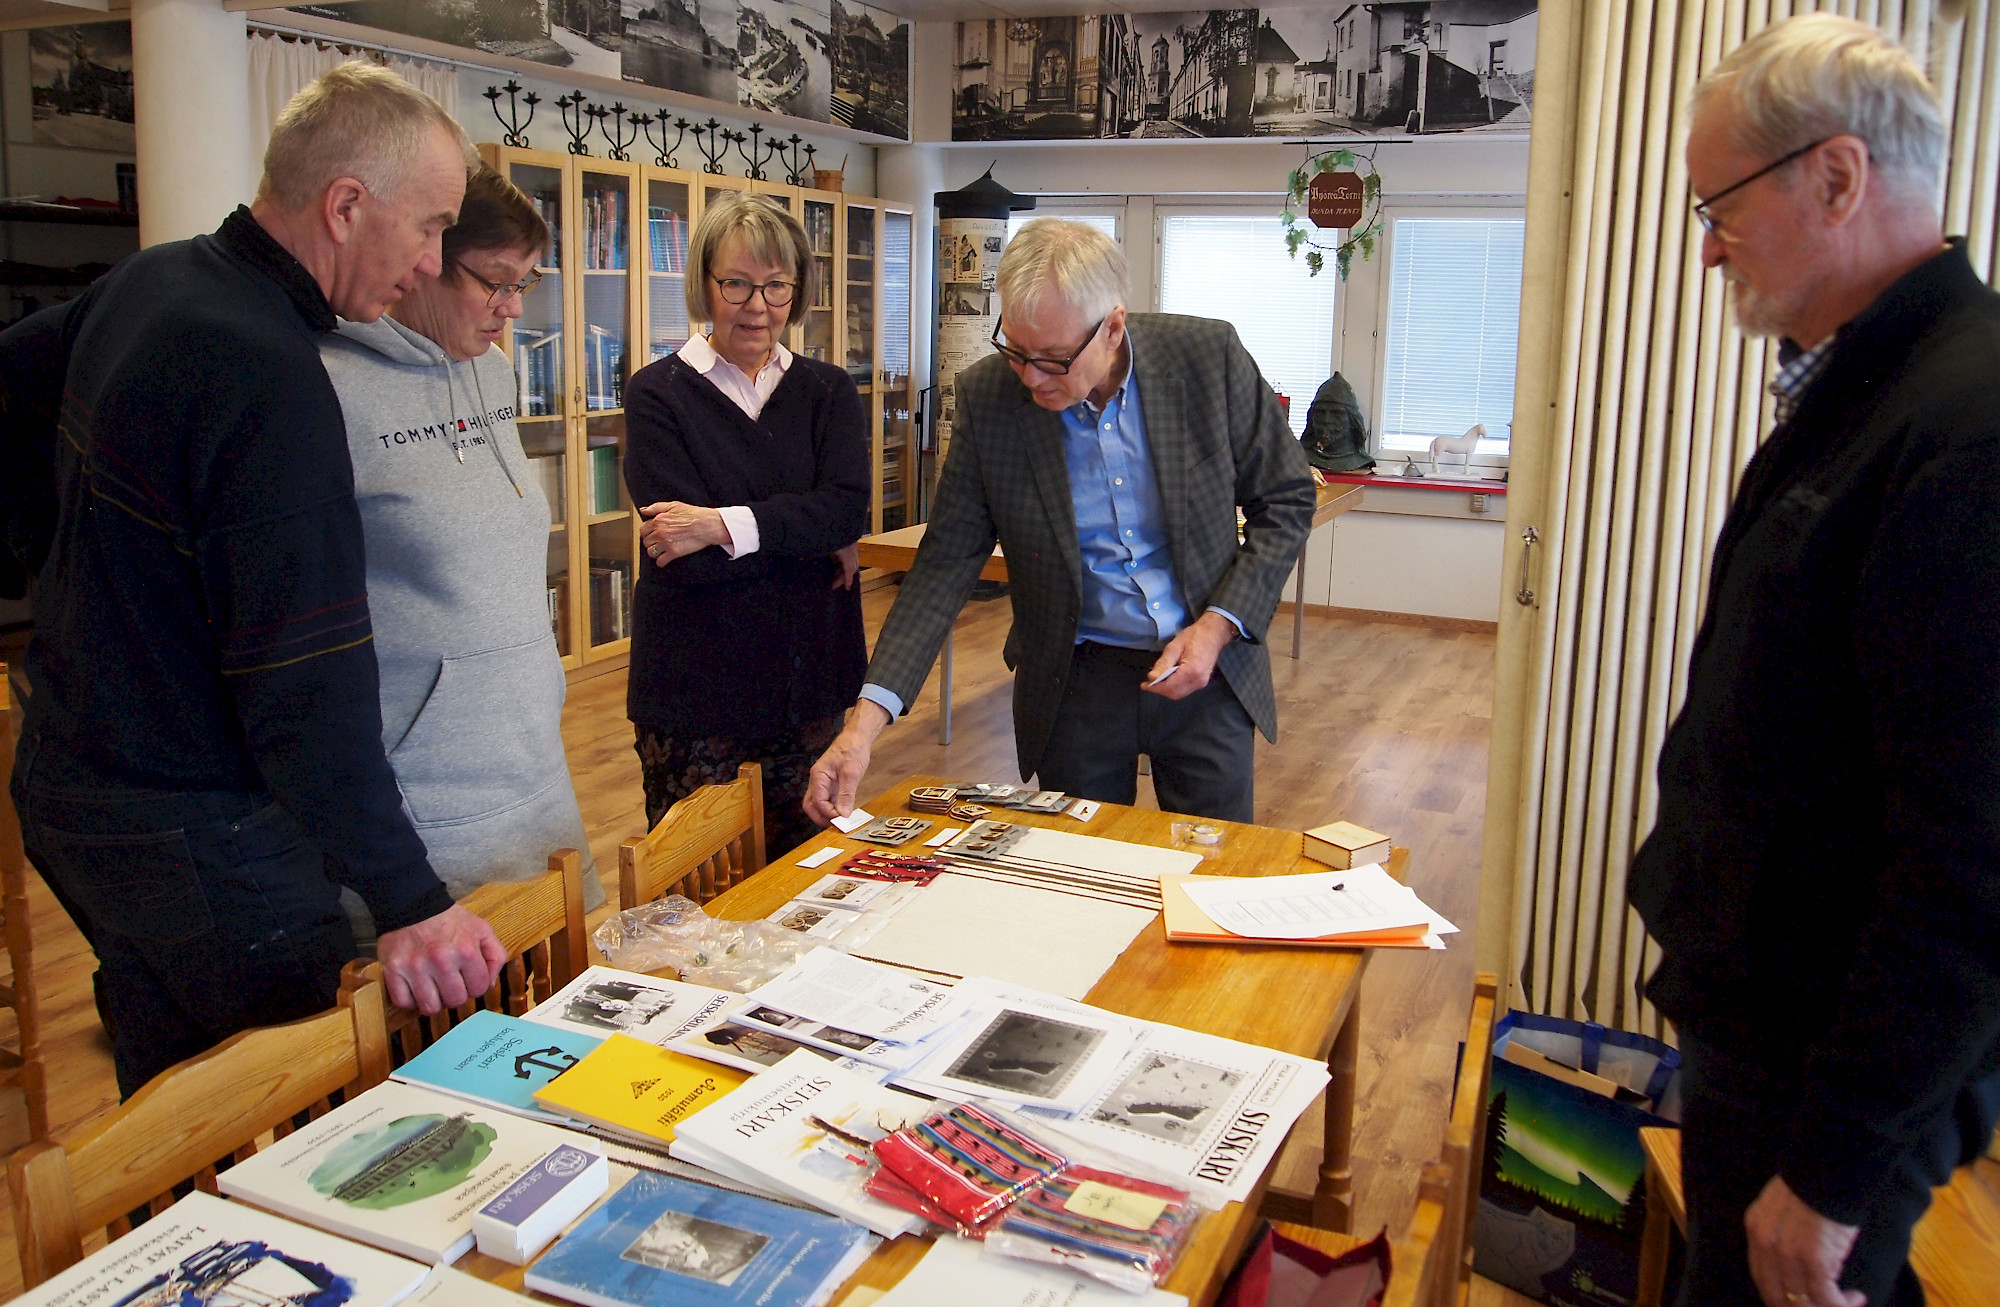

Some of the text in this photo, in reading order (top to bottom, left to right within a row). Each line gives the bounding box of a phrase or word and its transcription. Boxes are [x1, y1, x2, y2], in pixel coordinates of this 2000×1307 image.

[379, 423, 447, 448] TOMMY
[452, 436, 486, 450] ET. 1985
[453, 1027, 516, 1072] laulujen saari
[477, 1037, 523, 1070] Seiskari
[657, 1078, 716, 1127] Aamutähti
[731, 1074, 805, 1122] kotiseutukirja
[736, 1076, 832, 1138] SEISKARI
[1197, 1108, 1270, 1183] SEISKARI
[488, 1170, 543, 1215] SEISKARI
